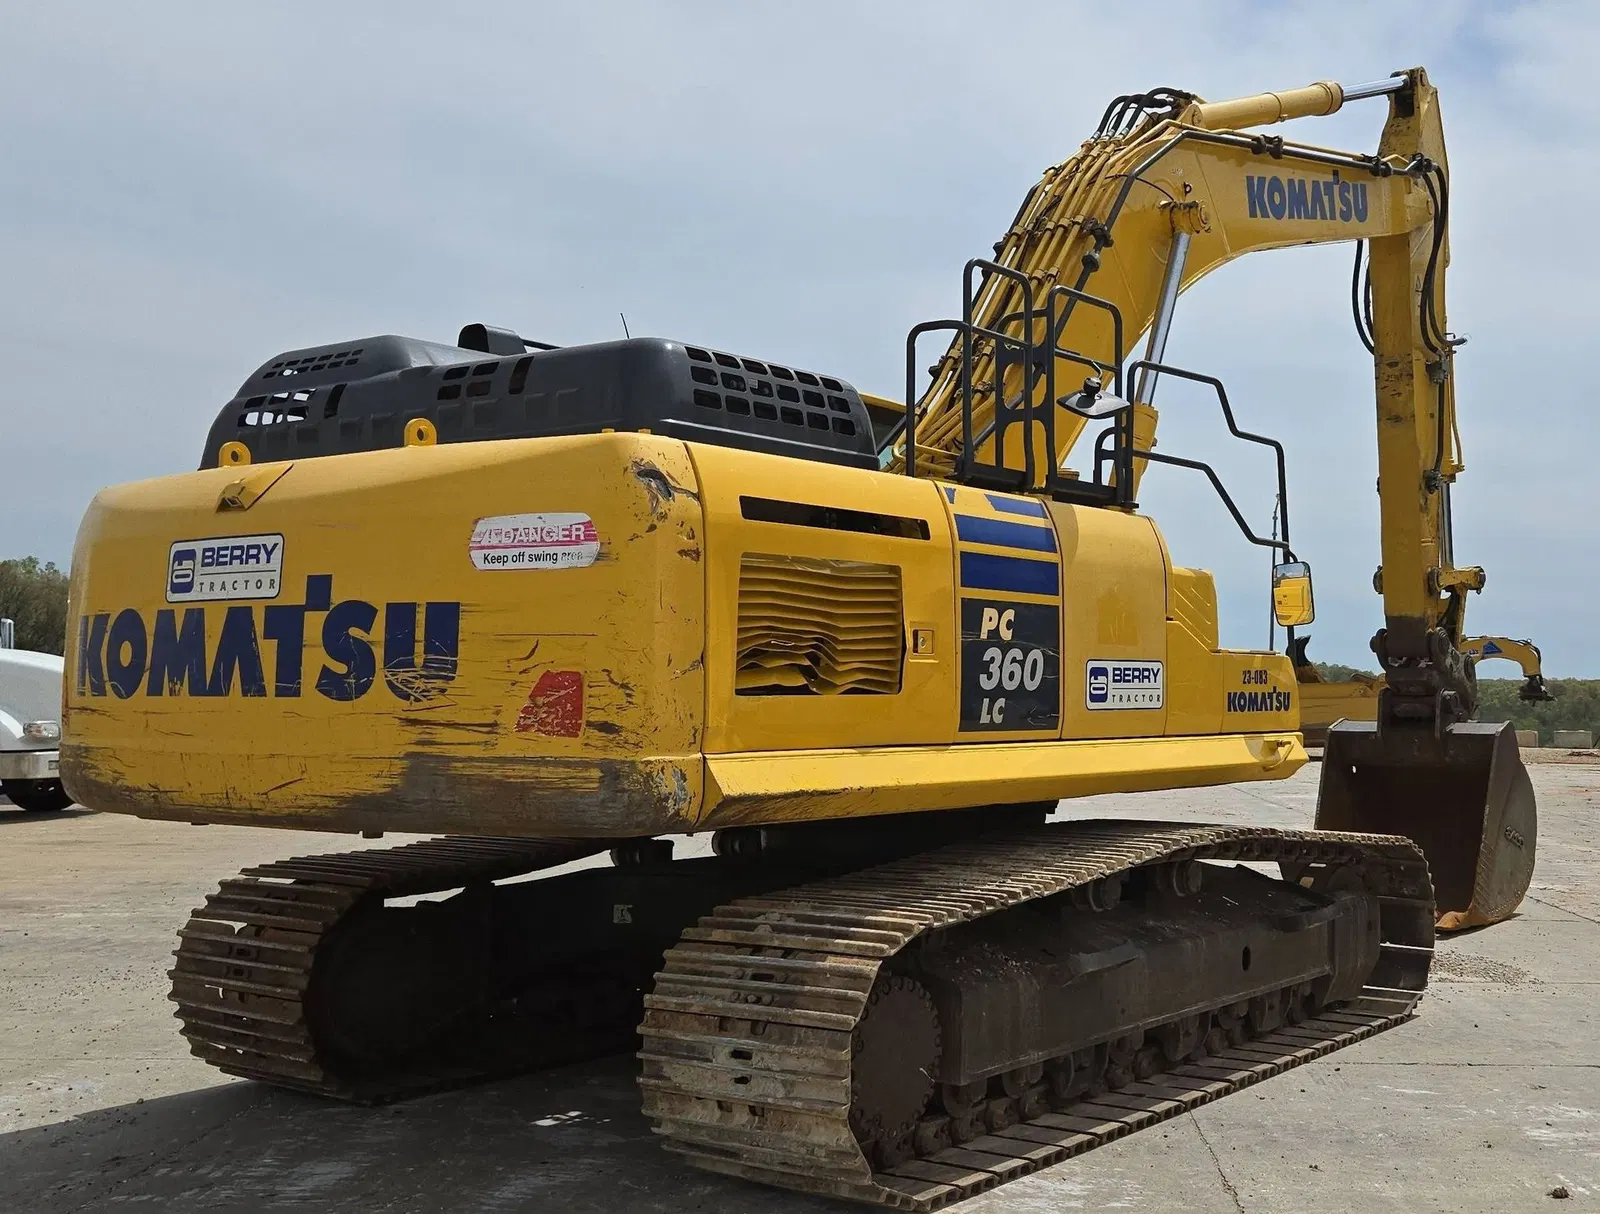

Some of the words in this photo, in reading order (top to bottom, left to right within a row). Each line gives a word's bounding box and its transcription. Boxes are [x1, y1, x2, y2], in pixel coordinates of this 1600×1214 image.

[1246, 169, 1368, 223] KOMATSU
[503, 524, 586, 544] DANGER
[201, 543, 279, 567] BERRY
[483, 552, 509, 566] Keep
[512, 551, 526, 563] off
[528, 551, 558, 564] swing
[200, 579, 276, 593] TRACTOR
[980, 607, 1015, 641] PC
[78, 574, 461, 702] KOMATSU
[979, 647, 1044, 691] 360
[1112, 667, 1160, 683] BERRY
[1242, 670, 1268, 684] 23-083
[979, 698, 1006, 724] LC
[1112, 695, 1160, 703] TRACTOR
[1227, 686, 1291, 712] KOMATSU
